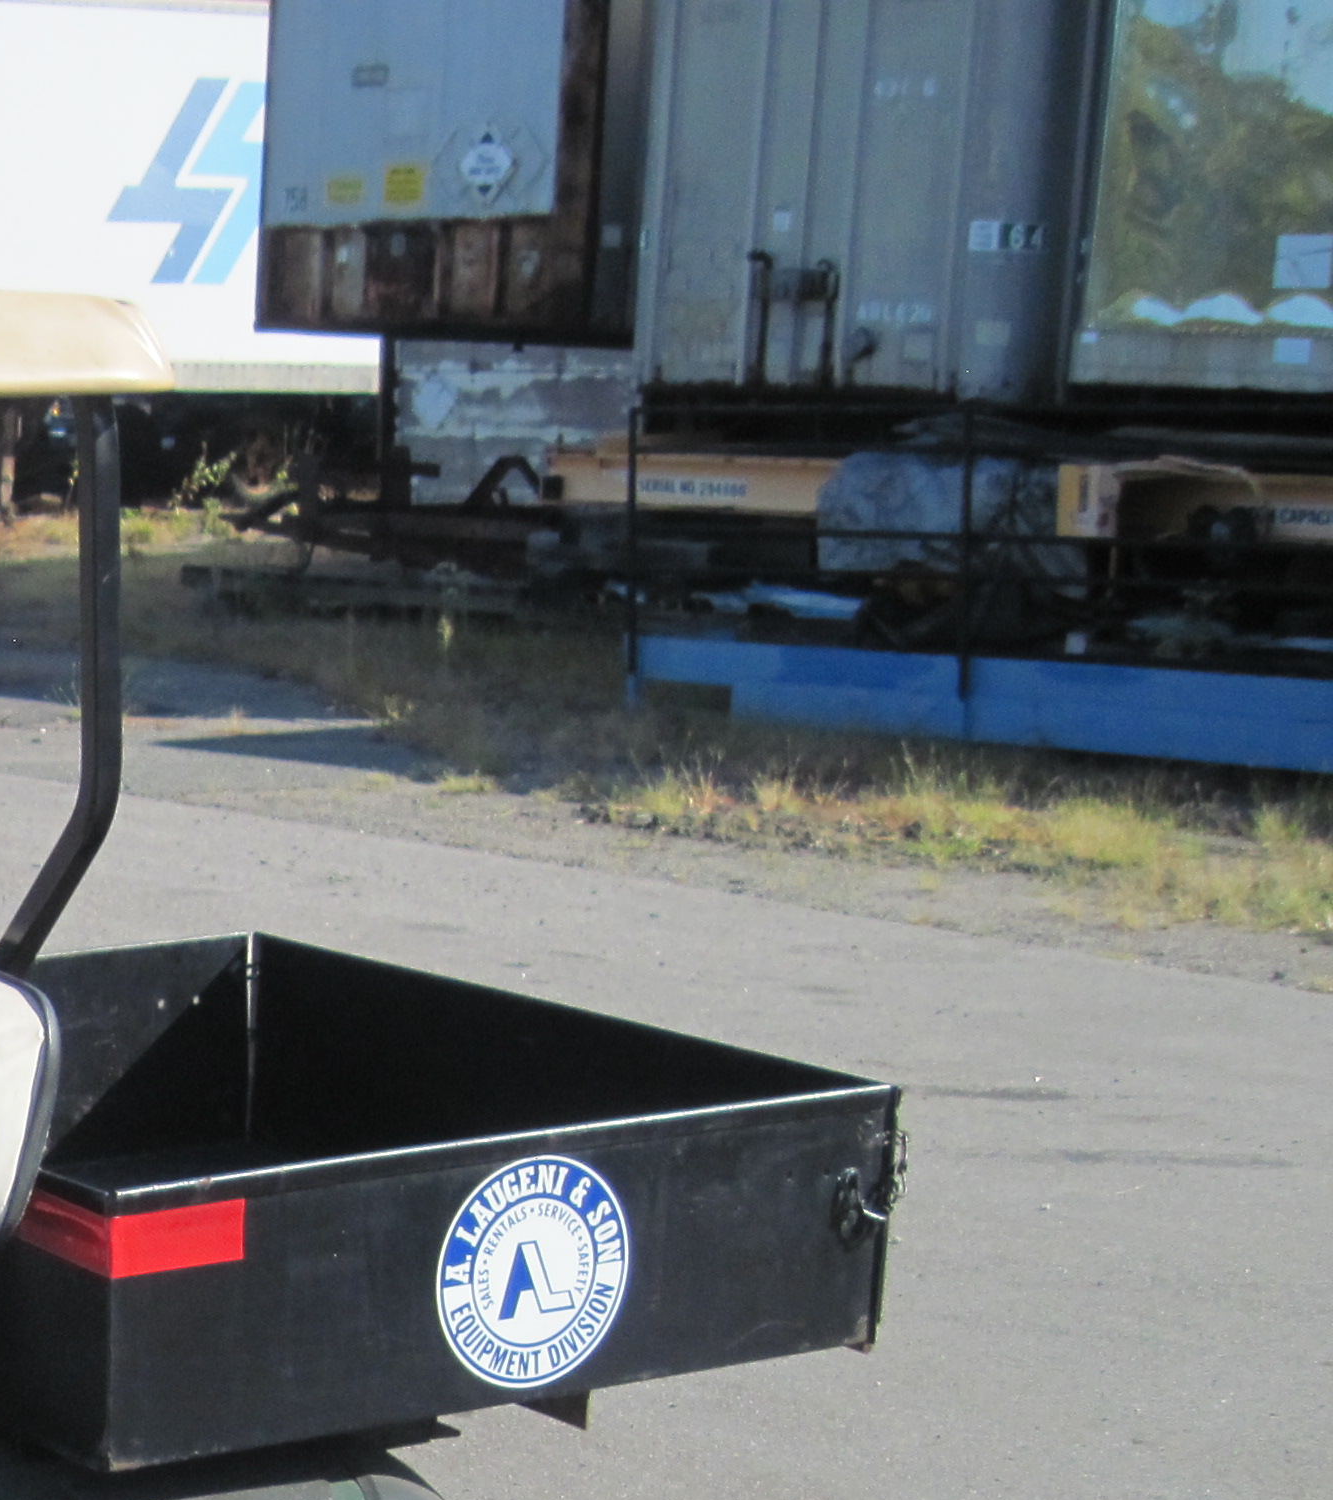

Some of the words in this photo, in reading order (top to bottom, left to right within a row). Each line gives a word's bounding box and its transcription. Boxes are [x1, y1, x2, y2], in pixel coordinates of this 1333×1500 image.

[455, 1163, 569, 1248] LAUGENI
[569, 1176, 591, 1208] &
[586, 1200, 623, 1265] SON
[484, 1205, 528, 1256] RENTALS
[537, 1202, 582, 1237] SERVICE
[477, 1268, 494, 1310] SALES
[573, 1242, 591, 1295] SAFETY
[450, 1301, 542, 1377] EQUIPMENT
[547, 1281, 616, 1370] DIVISION
